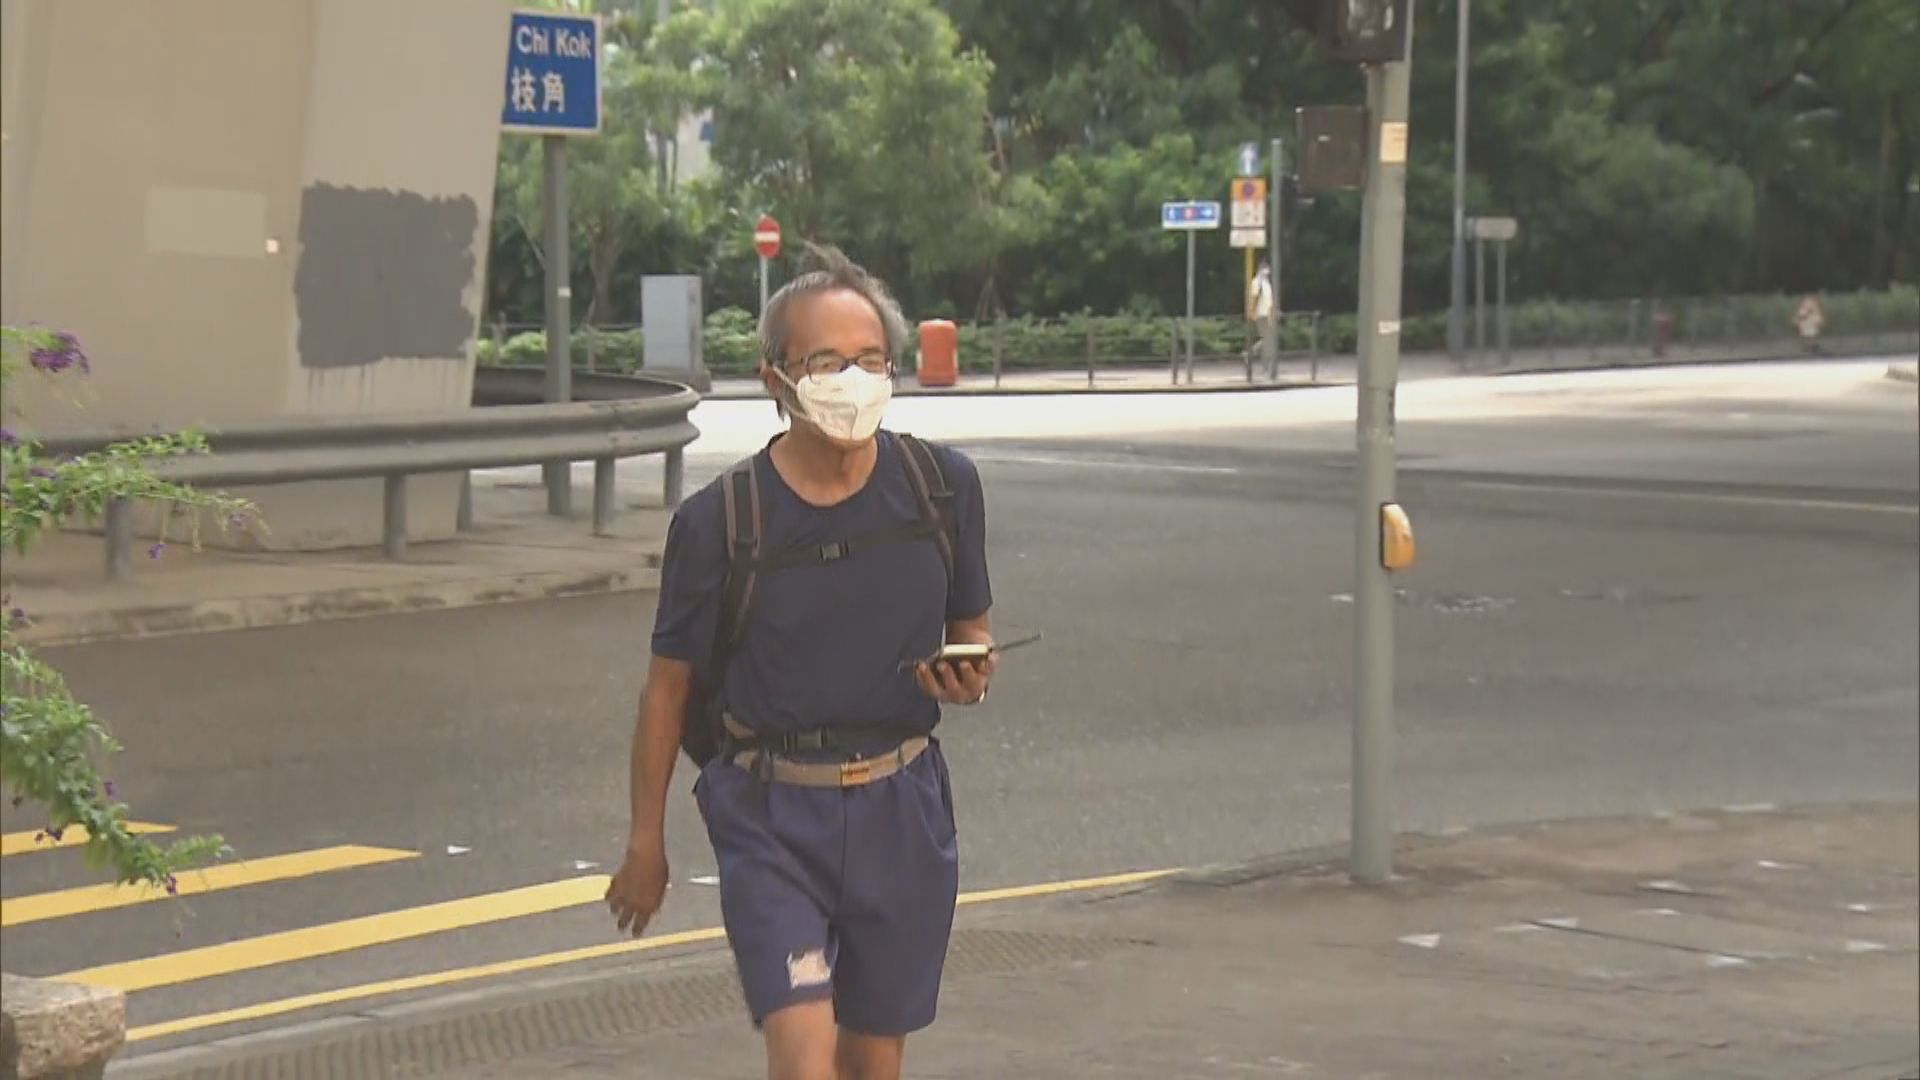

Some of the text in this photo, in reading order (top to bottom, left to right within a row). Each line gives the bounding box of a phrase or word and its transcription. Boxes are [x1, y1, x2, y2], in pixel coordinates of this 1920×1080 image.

[516, 25, 592, 59] Chi Kok
[511, 66, 565, 113] 枝角
